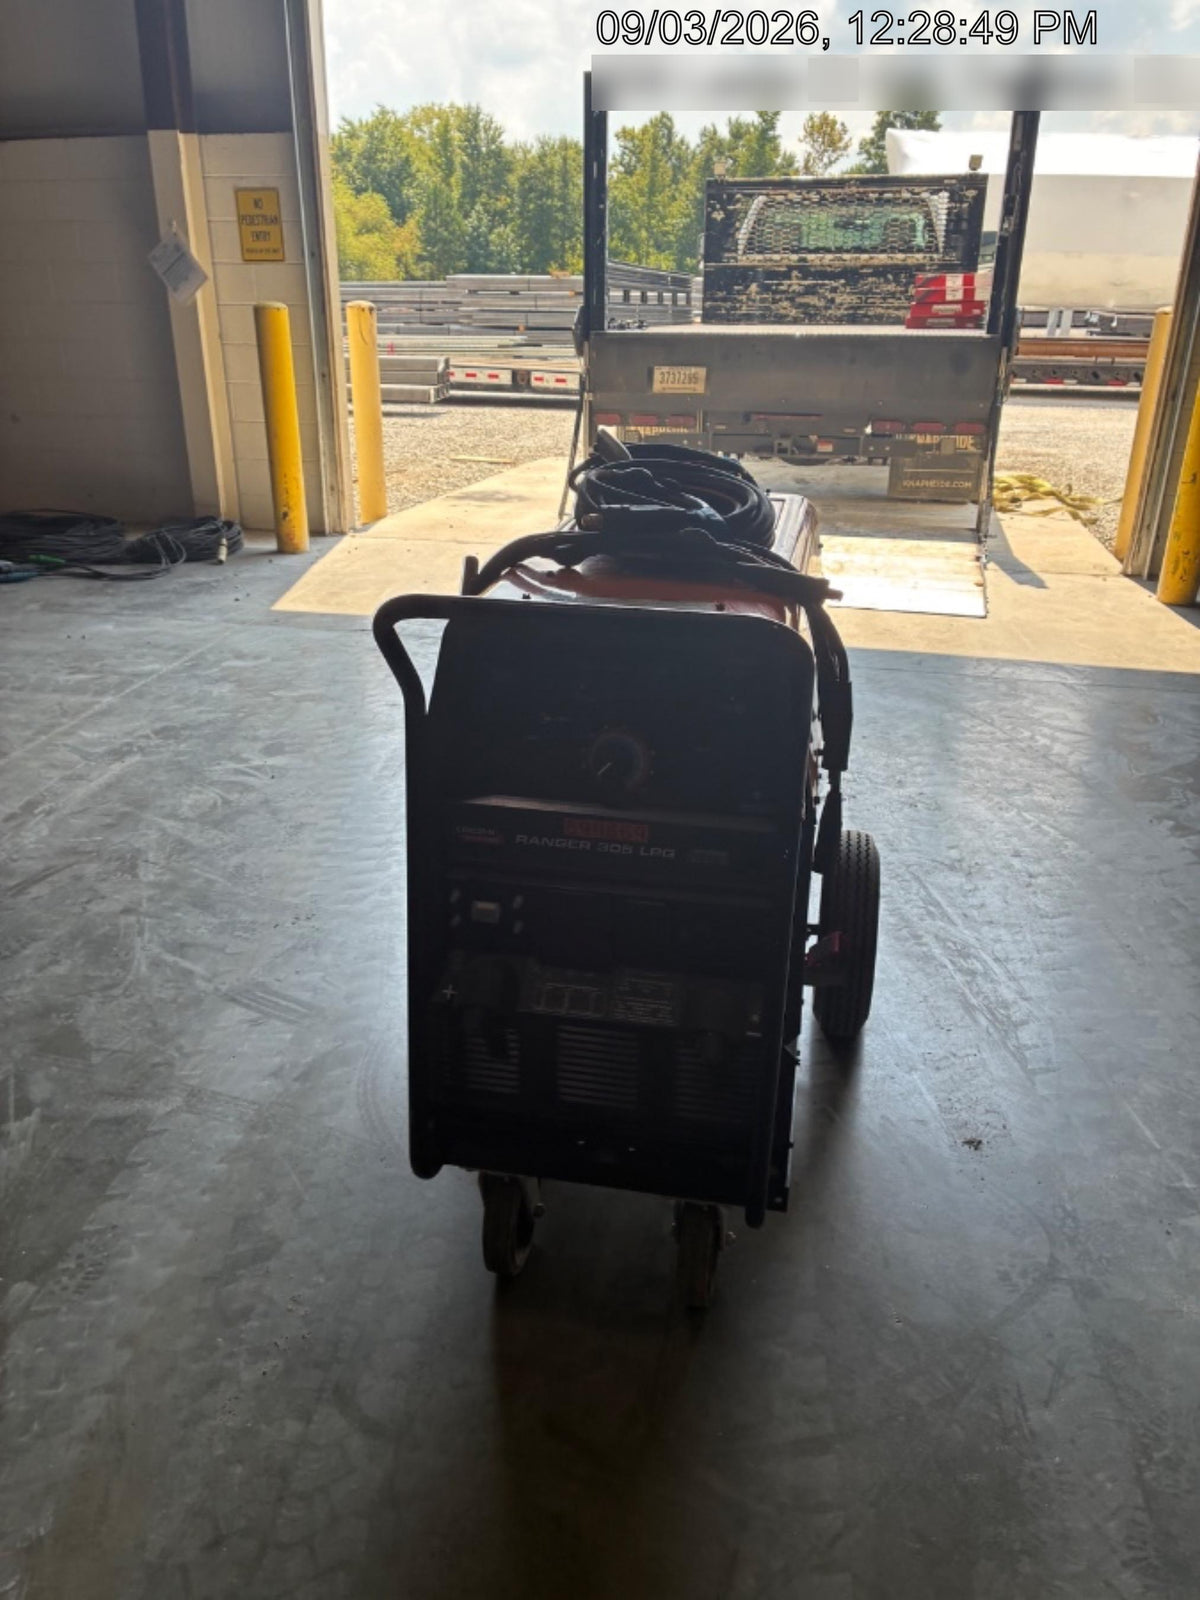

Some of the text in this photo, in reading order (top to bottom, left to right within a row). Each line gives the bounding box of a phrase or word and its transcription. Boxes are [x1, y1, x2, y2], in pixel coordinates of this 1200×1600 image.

[253, 198, 264, 210] NO
[515, 834, 591, 851] RANGER
[639, 847, 676, 859] LPG
